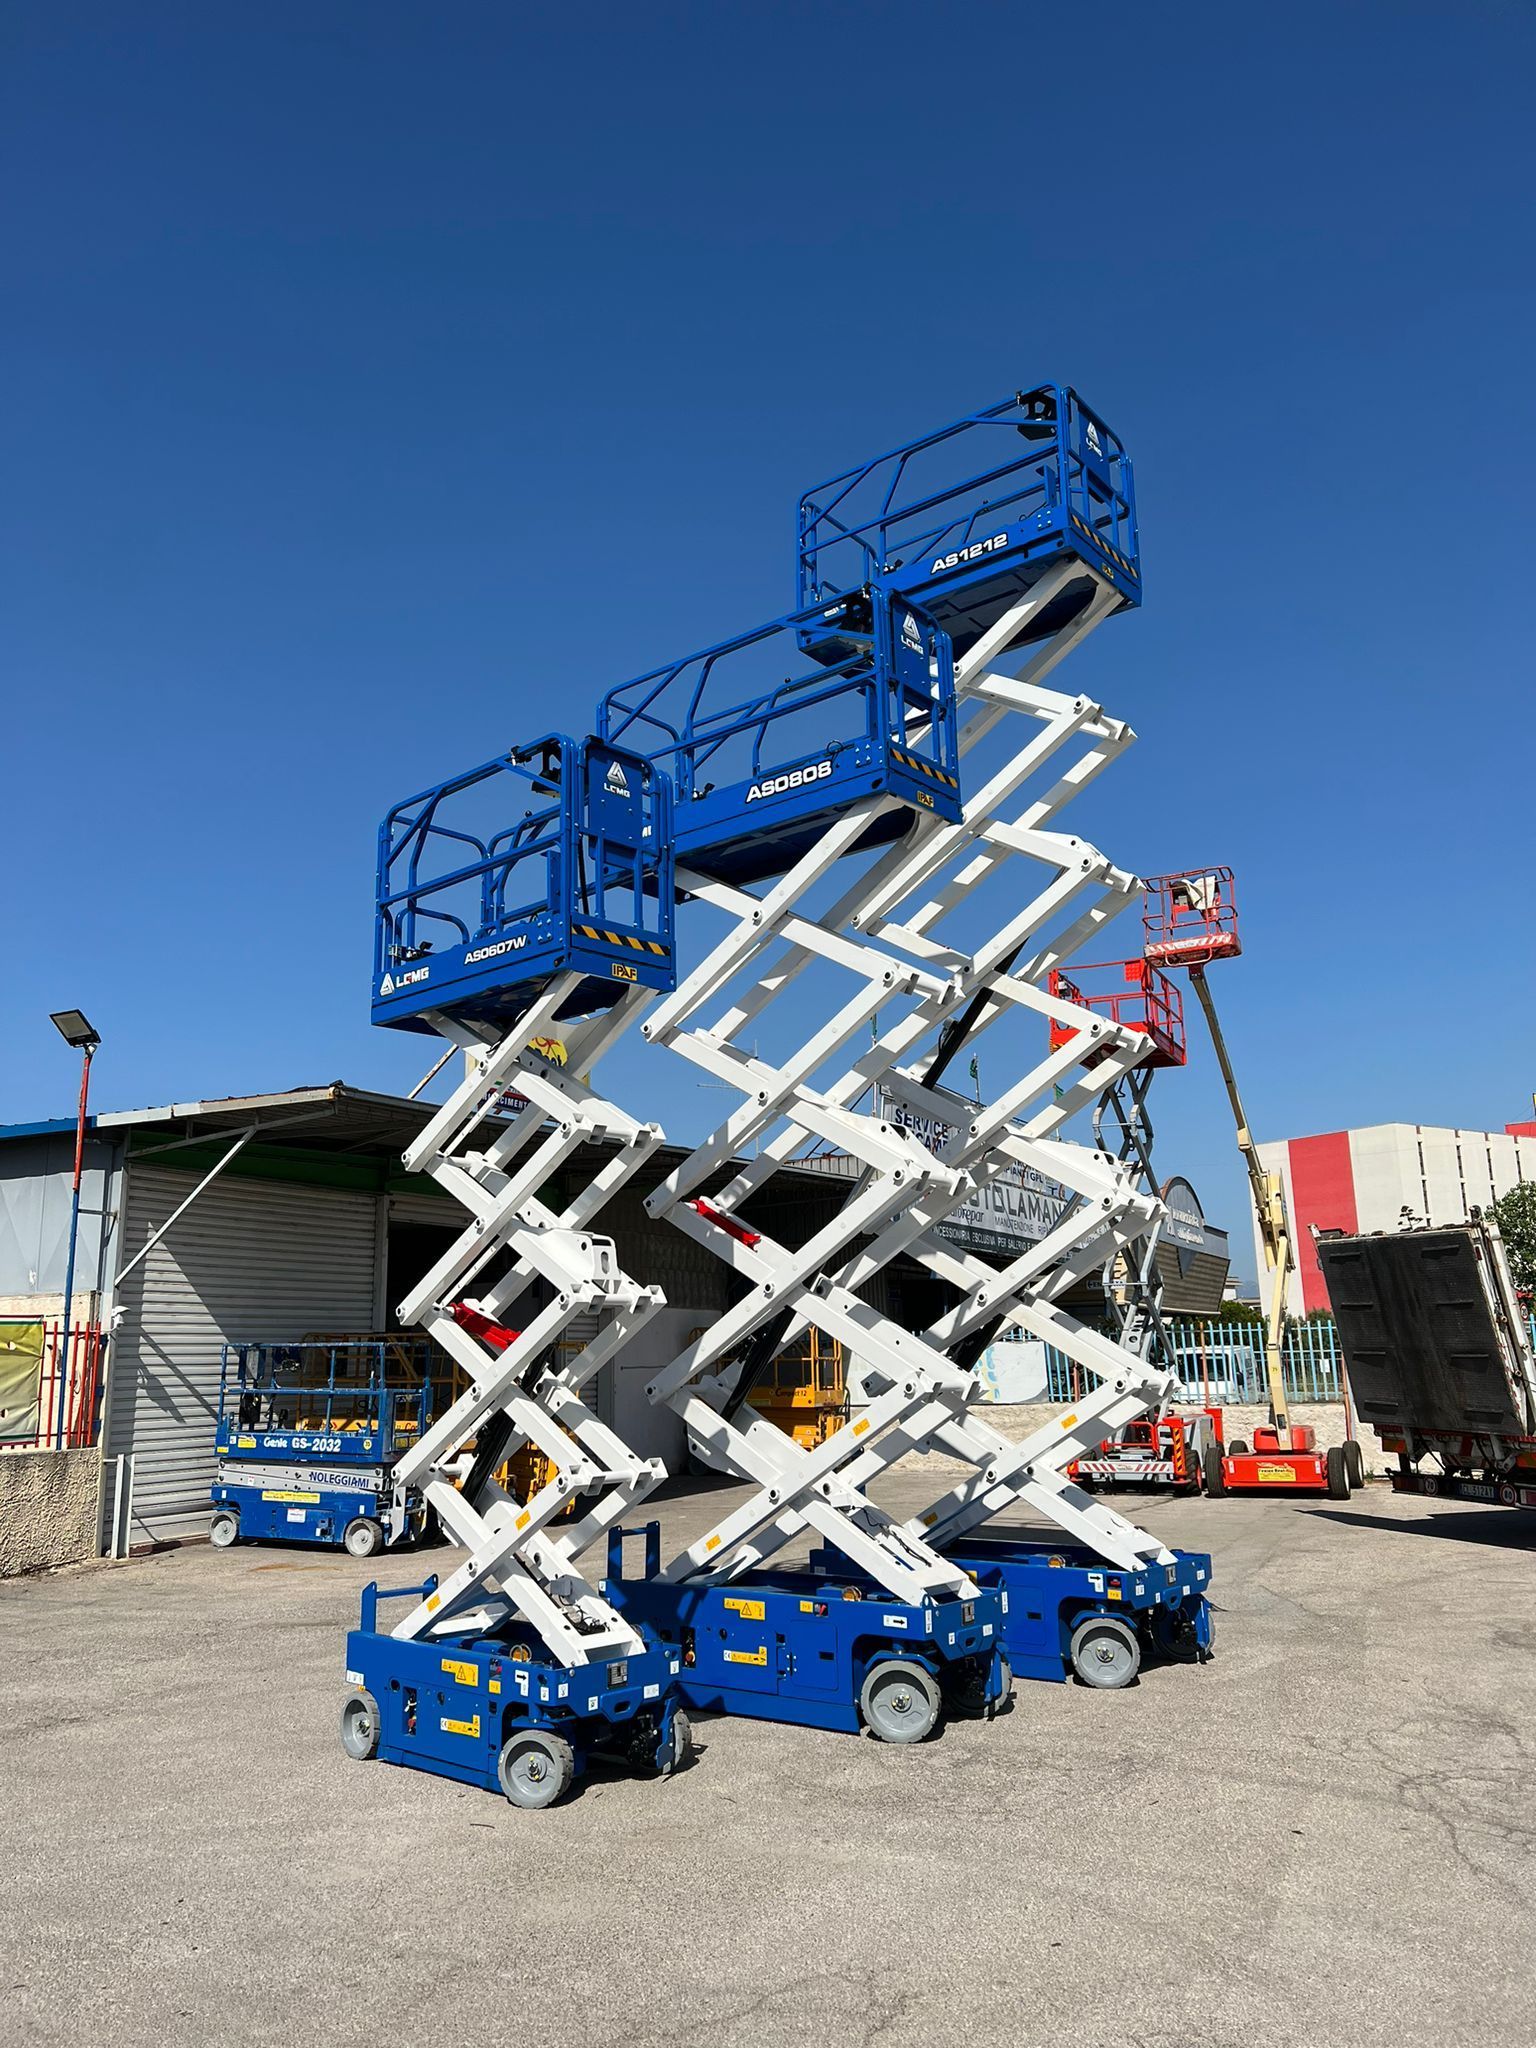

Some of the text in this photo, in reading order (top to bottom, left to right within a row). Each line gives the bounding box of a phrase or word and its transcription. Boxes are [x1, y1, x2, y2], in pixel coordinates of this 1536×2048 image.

[930, 532, 1008, 574] AS1212
[900, 634, 924, 655] LCMG
[603, 782, 631, 798] LCMG
[745, 760, 833, 803] AS0808
[463, 934, 527, 965] AS0607W
[395, 966, 430, 988] LCMG
[613, 963, 636, 979] IPAF
[895, 1108, 949, 1140] SERVICE
[1029, 1170, 1043, 1184] GPL
[997, 1237, 1007, 1247] PER
[263, 1436, 288, 1448] Genie
[291, 1436, 342, 1453] GS-2032
[309, 1471, 370, 1489] NOLEGGIAMI
